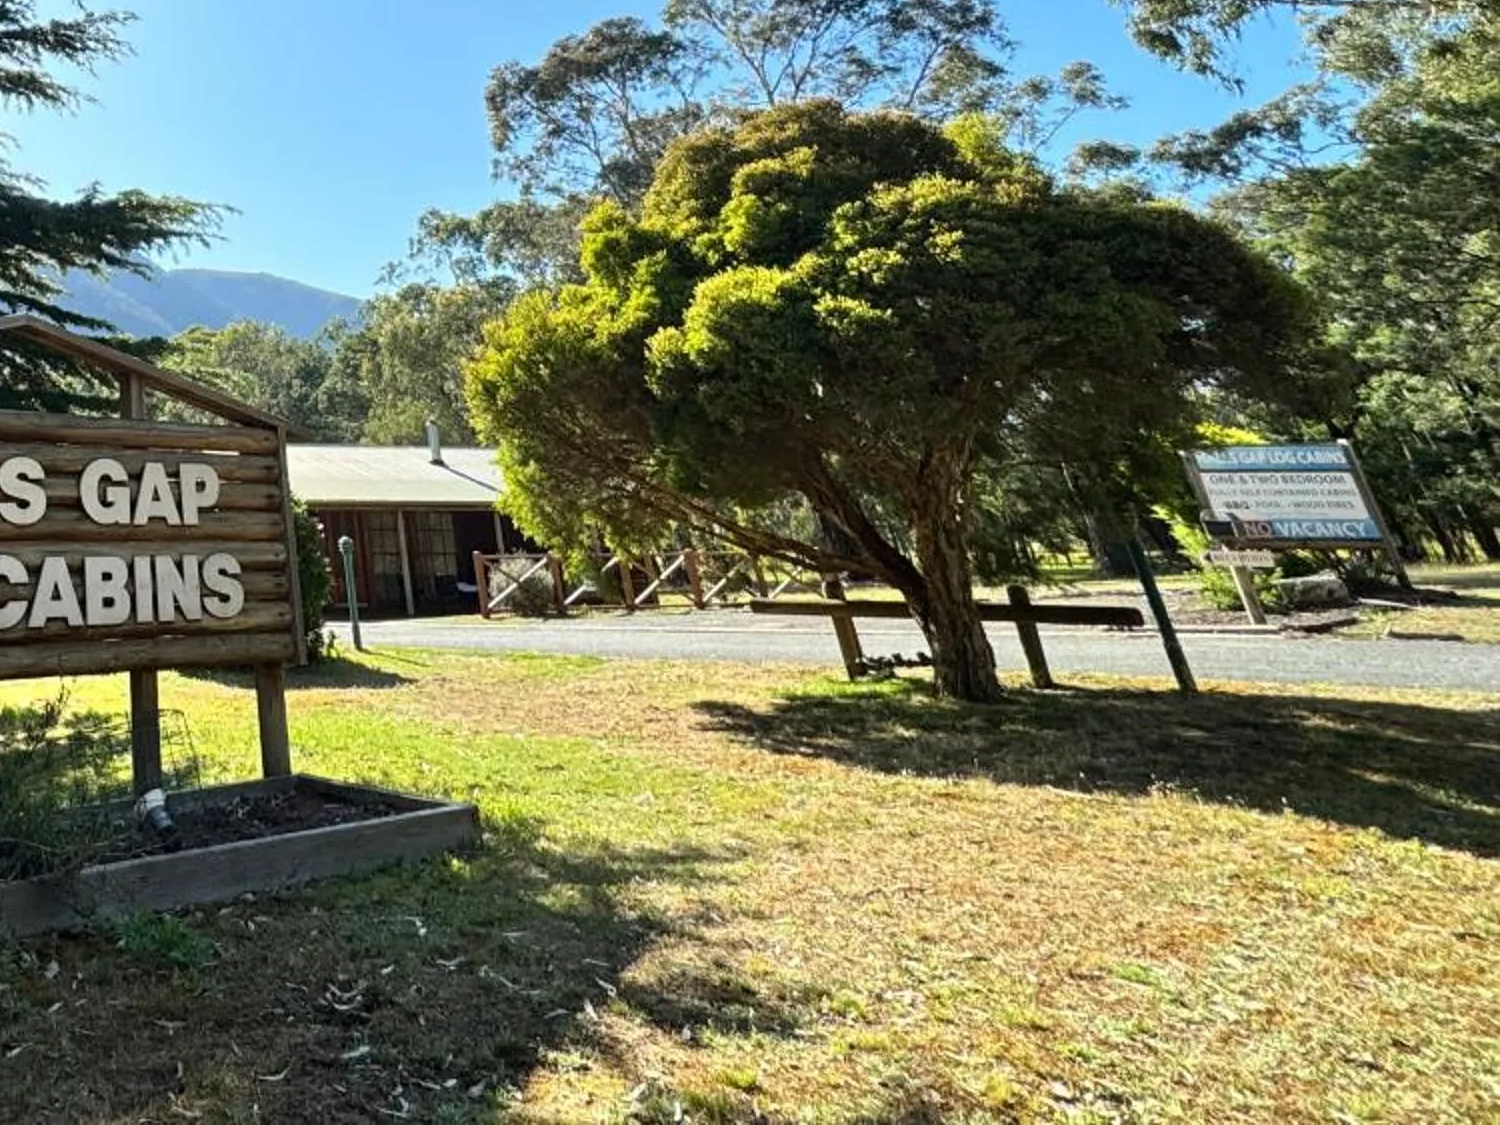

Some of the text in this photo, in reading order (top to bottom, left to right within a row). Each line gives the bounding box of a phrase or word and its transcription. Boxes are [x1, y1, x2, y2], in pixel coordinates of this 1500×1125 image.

[1268, 450, 1297, 464] LOG
[1297, 450, 1347, 464] CABINS
[1209, 474, 1237, 485] ONE
[1249, 474, 1279, 485] TWO
[1280, 474, 1346, 485] BEDROOM
[79, 458, 220, 526] GAP
[1243, 521, 1366, 538] NO VACANCY
